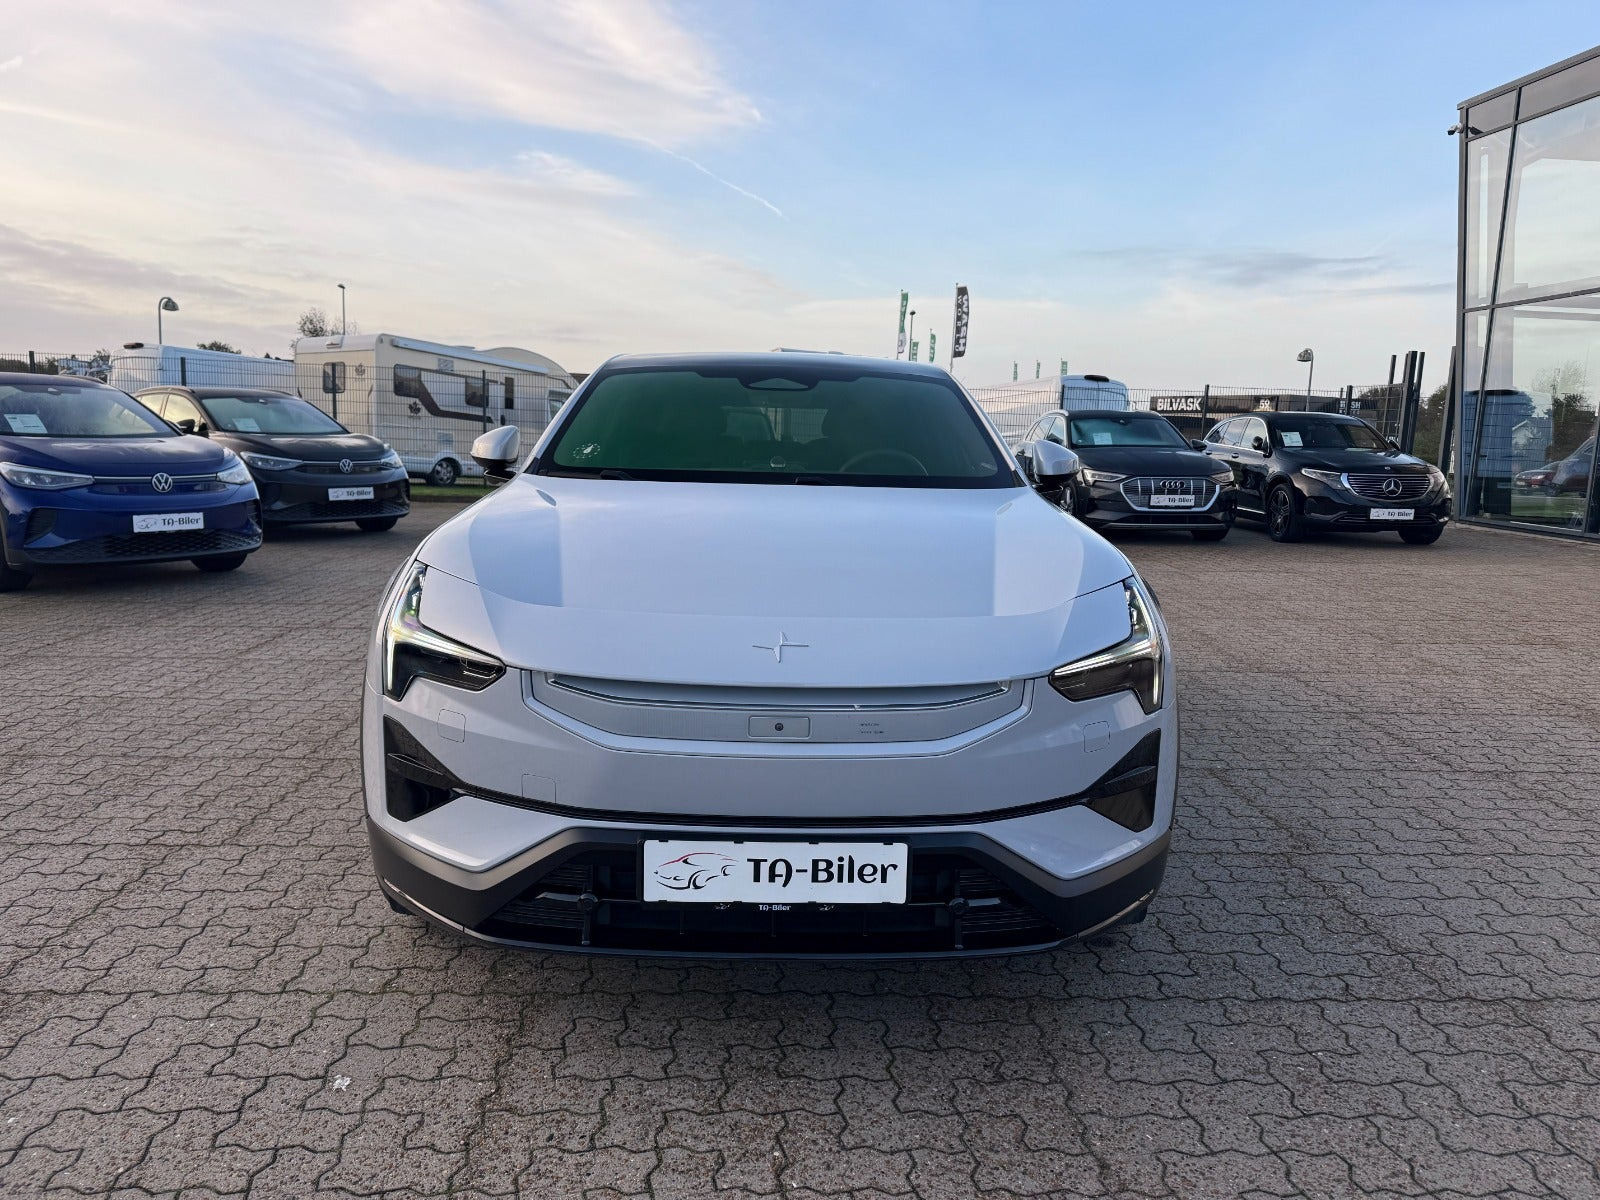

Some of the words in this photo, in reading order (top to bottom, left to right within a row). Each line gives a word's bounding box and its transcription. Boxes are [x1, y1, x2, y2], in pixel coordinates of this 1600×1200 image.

[959, 294, 969, 352] WASH
[1157, 397, 1202, 411] BILVASK
[161, 516, 201, 526] TA-Biler
[746, 854, 899, 888] TA-Biler
[758, 902, 791, 911] TA-Biler
